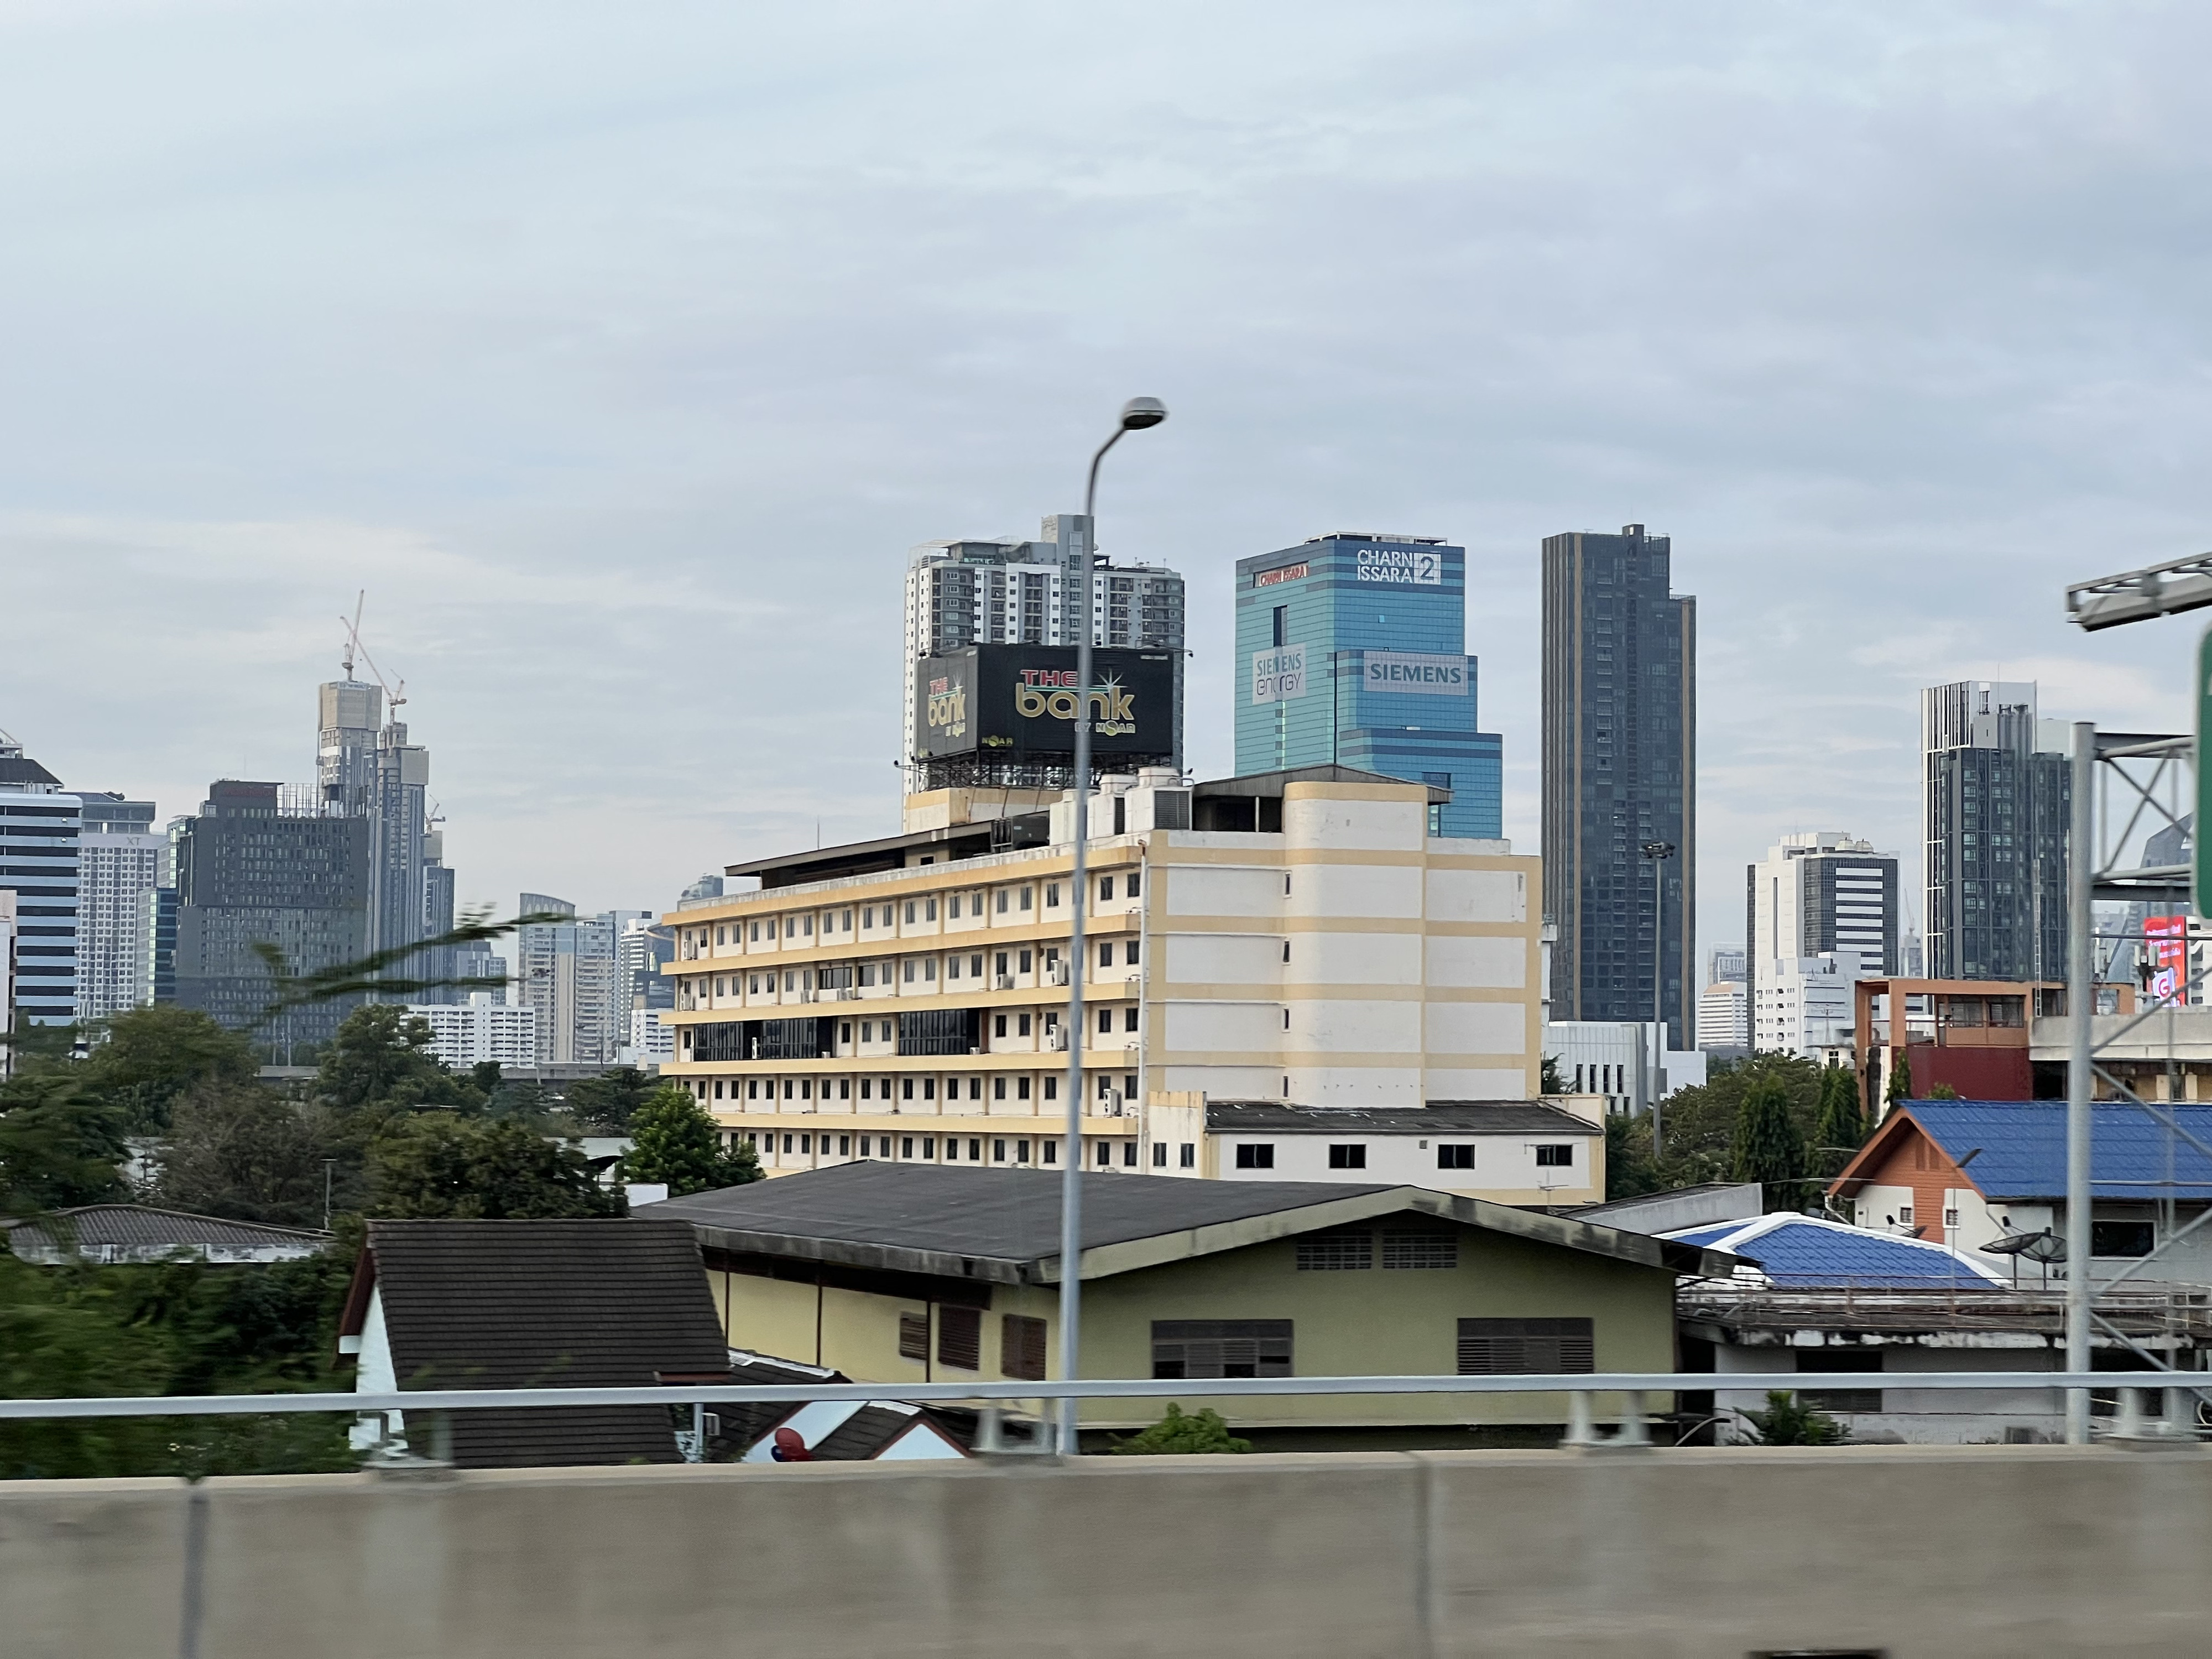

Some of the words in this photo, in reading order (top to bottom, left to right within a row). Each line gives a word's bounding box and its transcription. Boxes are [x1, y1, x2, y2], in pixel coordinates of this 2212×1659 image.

[1358, 549, 1412, 567] CHARN
[1358, 566, 1413, 583] ISSARA
[1420, 556, 1434, 581] 2
[1020, 670, 1078, 687] THE
[1370, 663, 1461, 684] SIEMENS
[930, 676, 948, 696] THE
[928, 690, 966, 727] bank
[1015, 682, 1135, 721] bank
